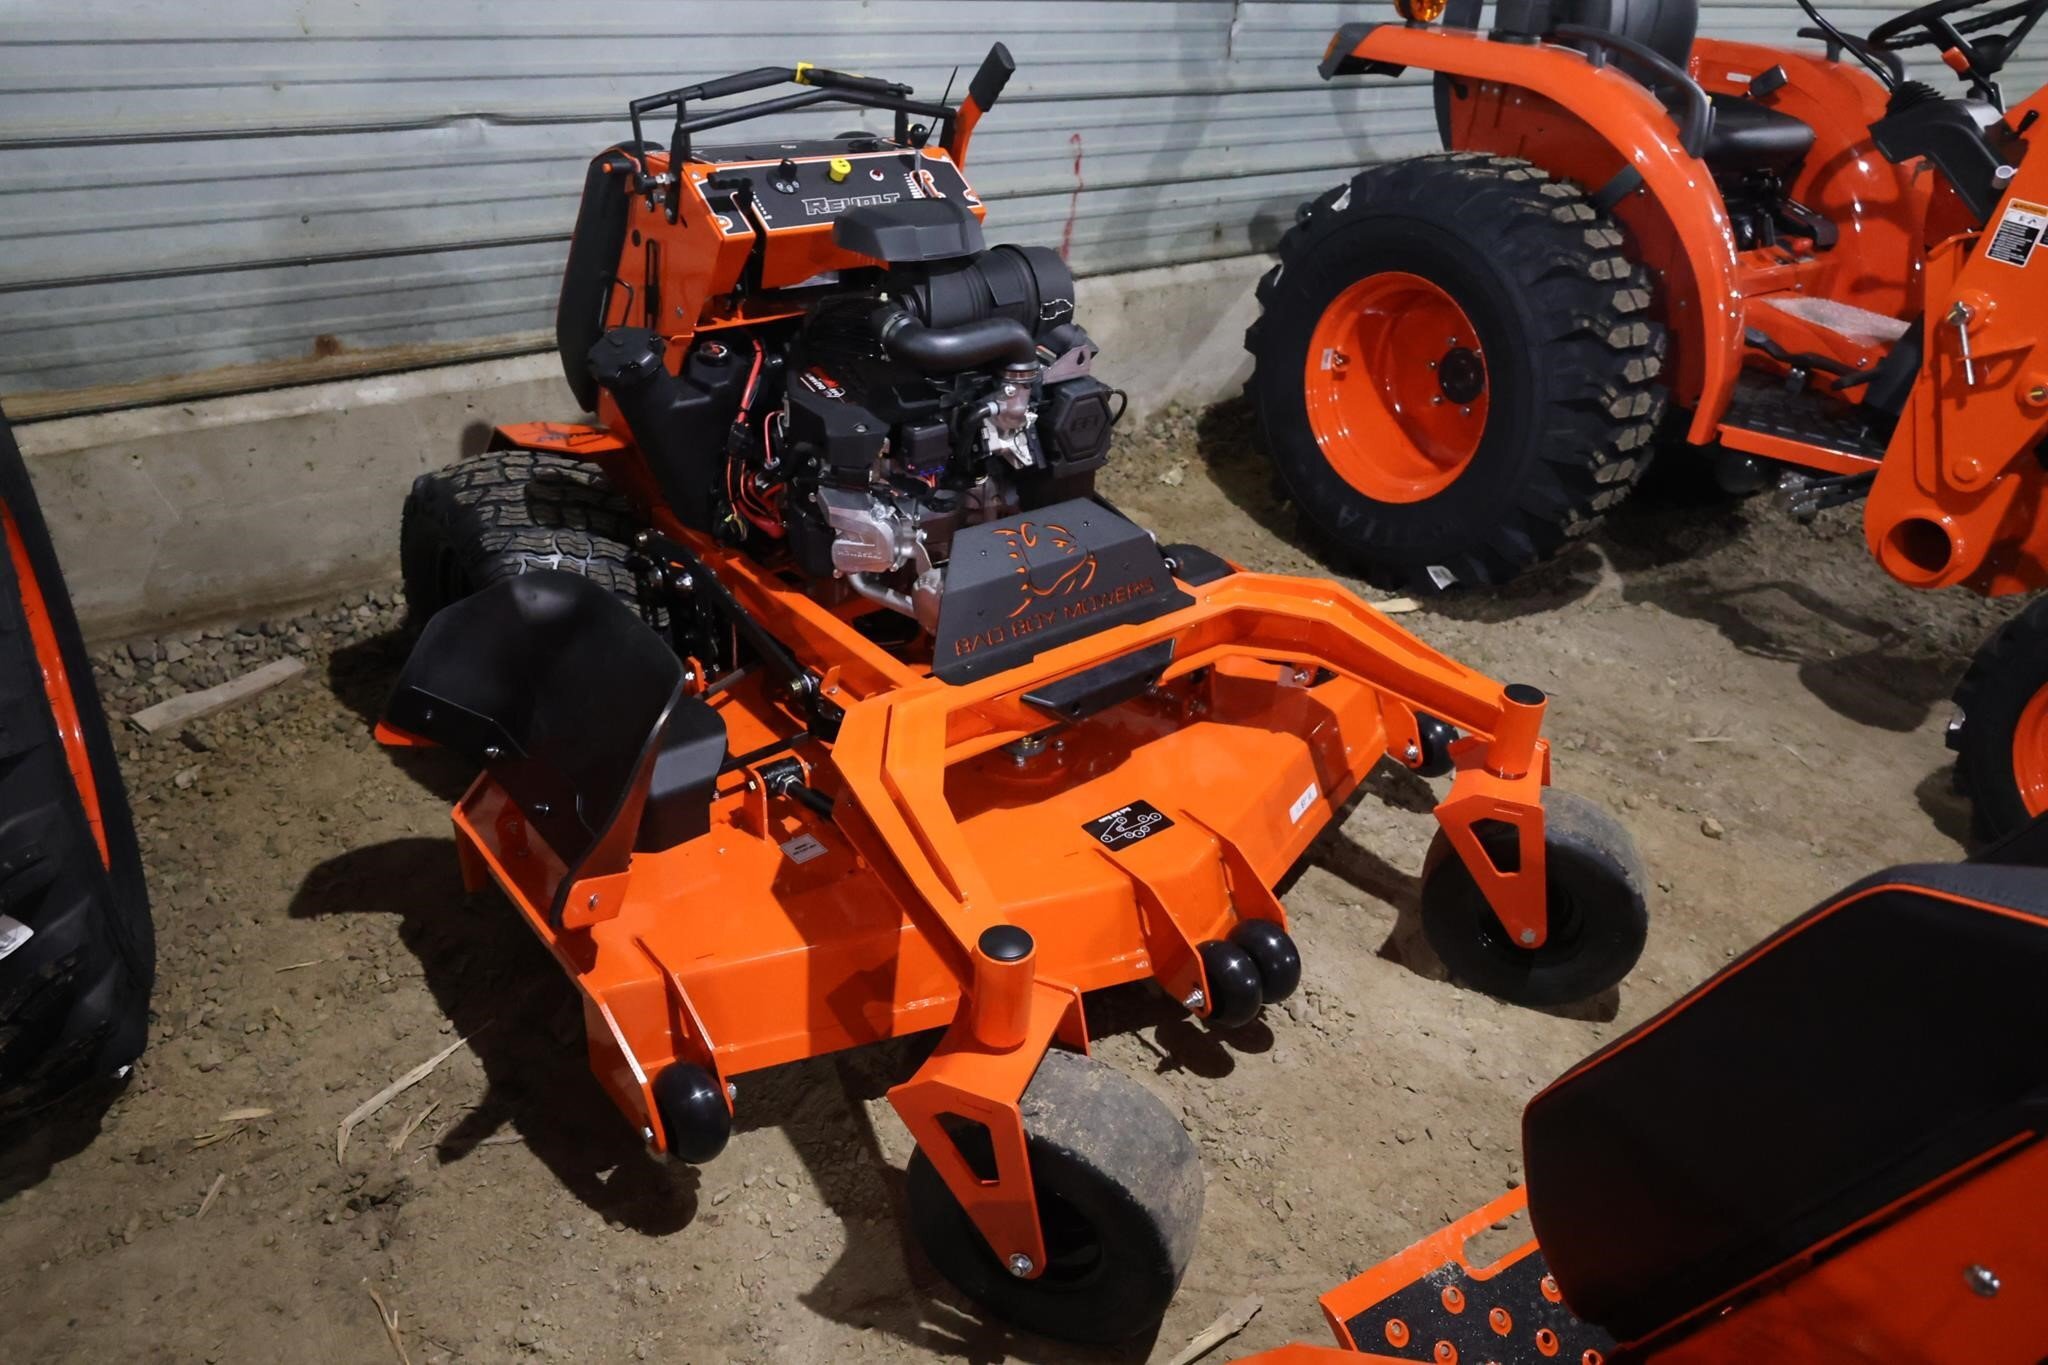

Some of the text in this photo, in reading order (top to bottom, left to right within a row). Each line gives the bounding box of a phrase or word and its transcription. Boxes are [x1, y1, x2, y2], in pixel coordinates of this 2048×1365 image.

[954, 576, 1155, 657] BAD BOY MOWERS
